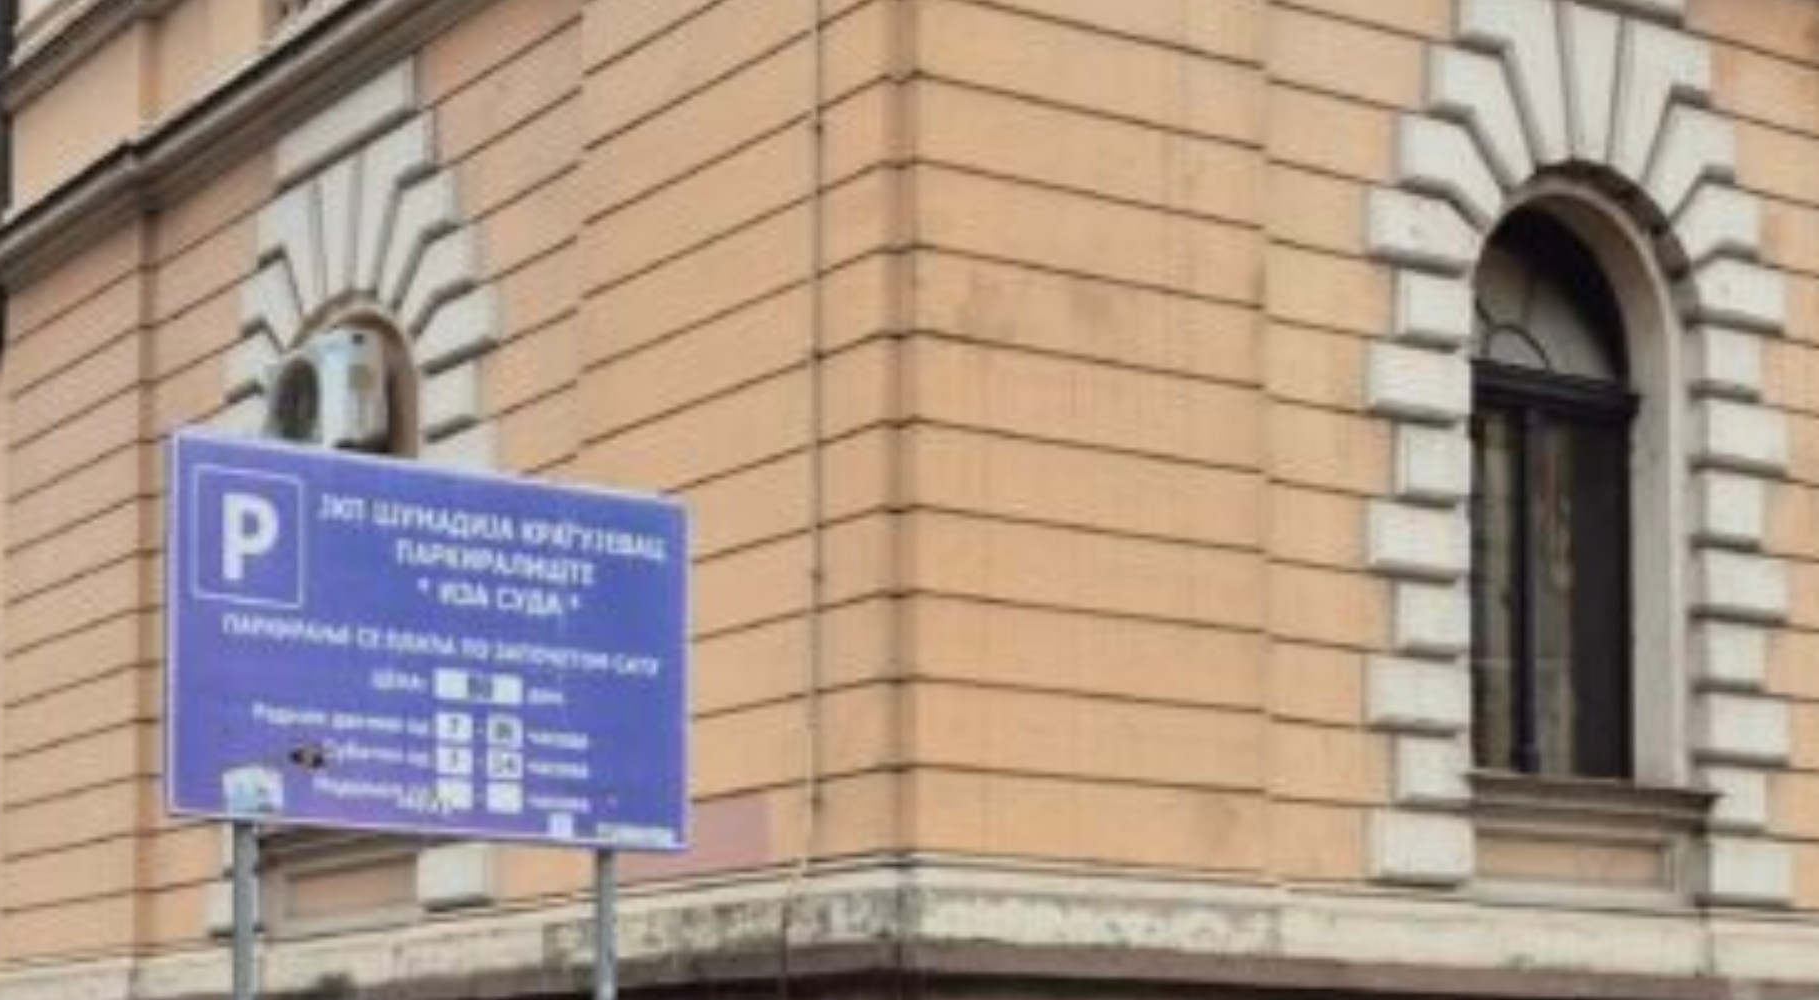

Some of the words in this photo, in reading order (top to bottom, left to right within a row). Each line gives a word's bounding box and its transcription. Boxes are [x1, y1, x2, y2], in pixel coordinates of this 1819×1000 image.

[222, 493, 279, 581] P
[373, 501, 513, 541] ШУМАДИЈА
[396, 537, 595, 586] ПАРКИРАЛИШТЕ
[496, 586, 563, 616] СУДА
